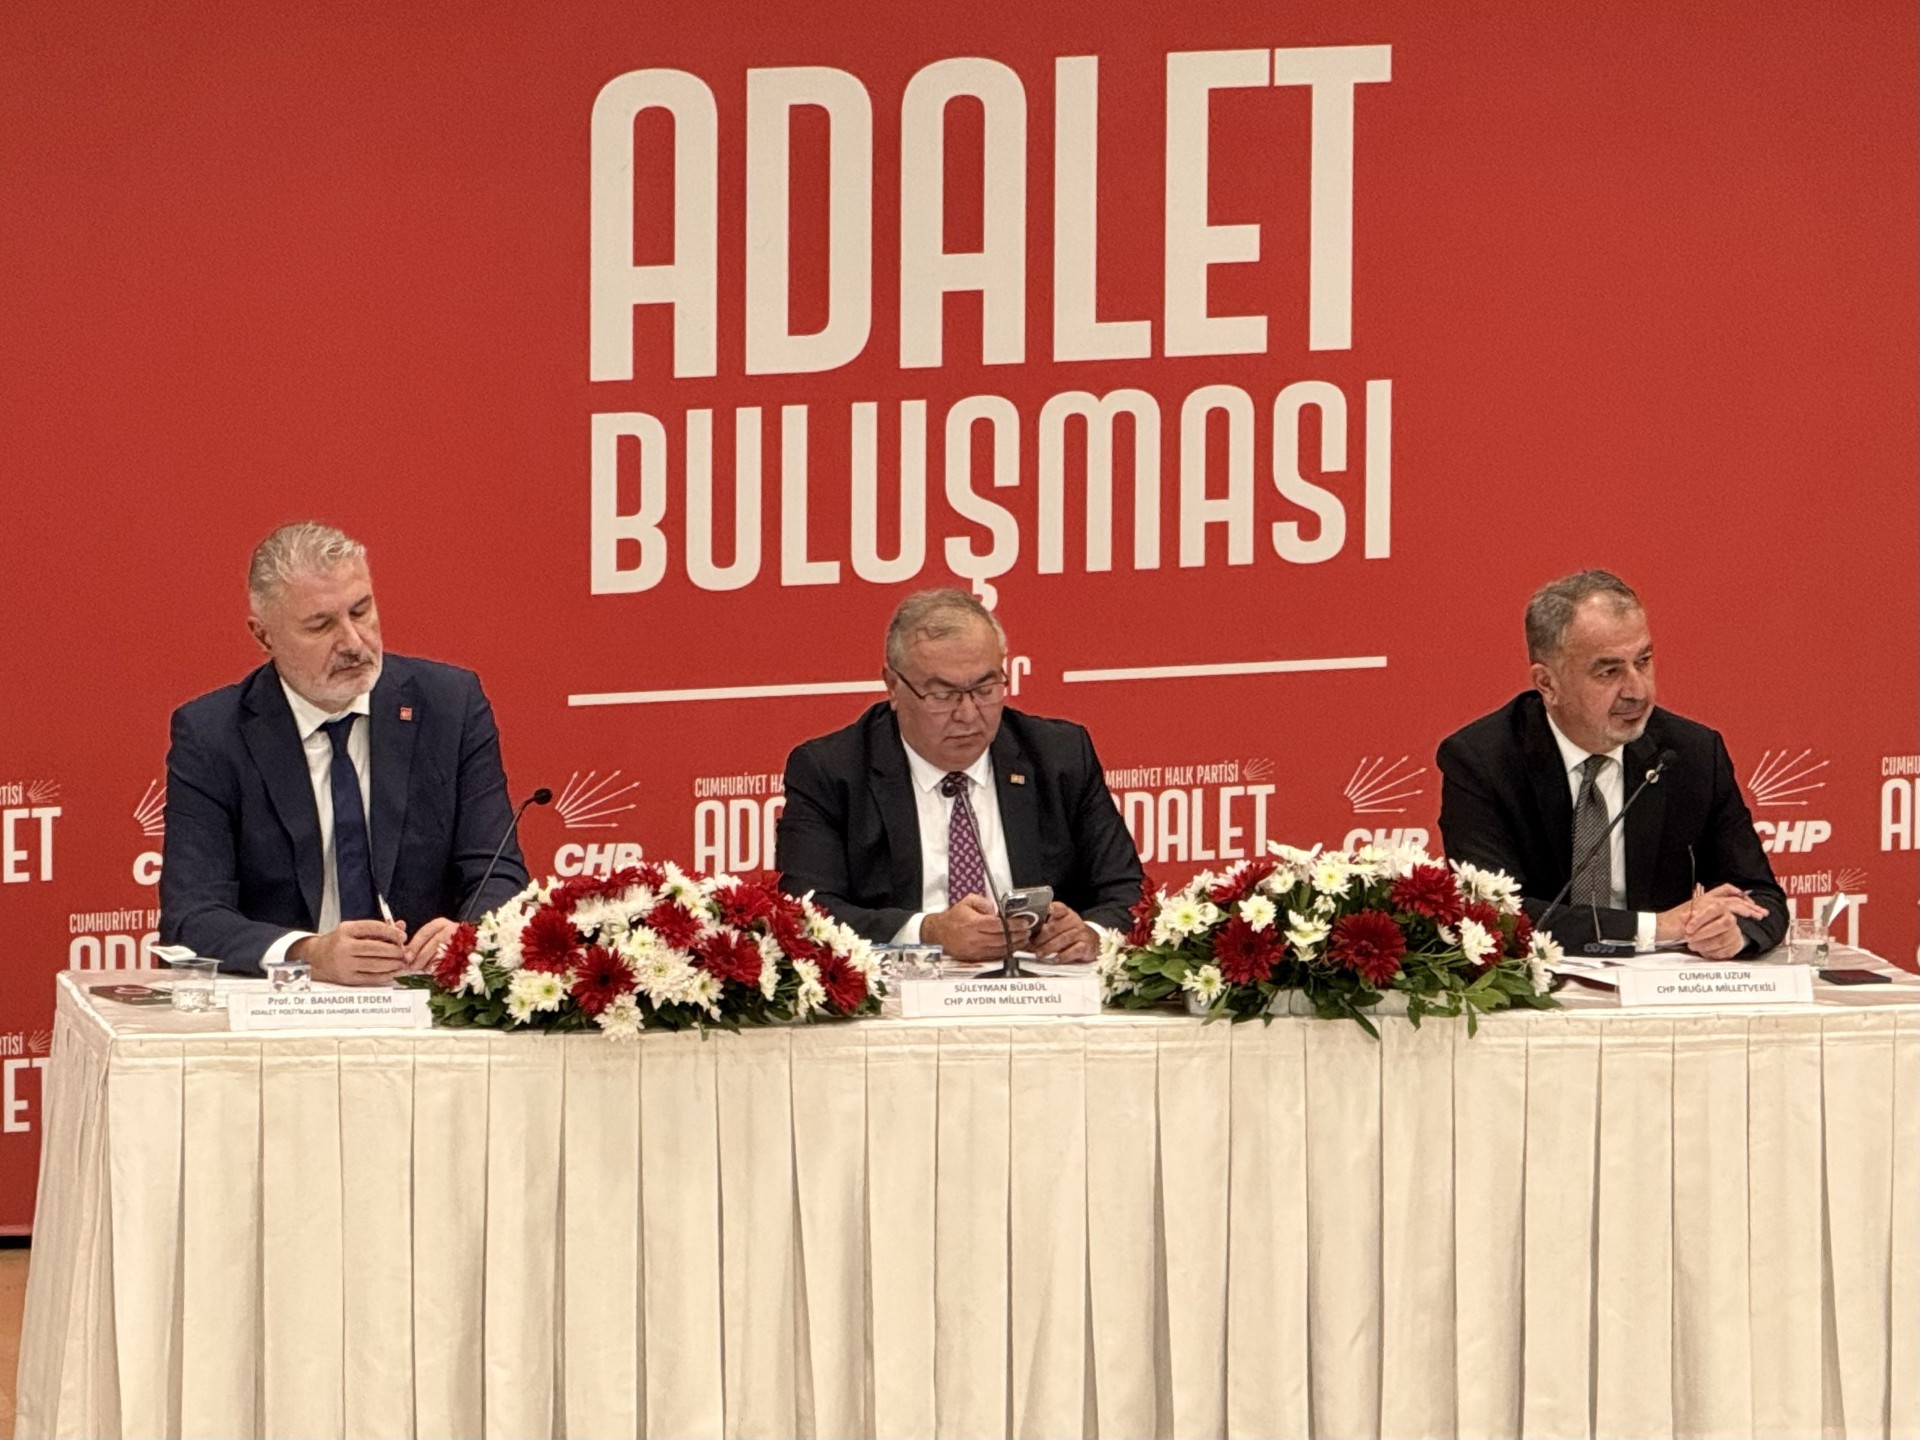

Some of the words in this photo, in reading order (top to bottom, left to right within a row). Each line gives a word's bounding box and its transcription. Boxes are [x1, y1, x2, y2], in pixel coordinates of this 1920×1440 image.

[590, 45, 1392, 384] ADALET
[590, 379, 1392, 611] BULUŞMASI
[695, 771, 768, 799] CUMHURİYET
[1105, 764, 1163, 789] MHURİYET
[1165, 766, 1194, 786] HALK
[1196, 759, 1239, 785] PARTİSİ
[1112, 783, 1276, 864] DALET
[1754, 820, 1832, 854] CHP
[1790, 870, 1832, 894] PARTİSİ
[69, 907, 144, 934] CUMHURİYET
[954, 982, 1008, 993] SÜLEYMAN
[1009, 981, 1048, 992] BÜLBÜL
[1656, 985, 1675, 994] CHP
[1678, 983, 1713, 994] MUĞLA
[1715, 981, 1776, 992] MİLLETVEKİLİ
[1678, 971, 1722, 981] CUMHUR
[1724, 971, 1751, 980] UZUN
[311, 995, 354, 1005] BAHADIR
[357, 995, 392, 1004] ERDEM
[944, 996, 964, 1006] CHP
[966, 996, 996, 1006] AYDIN
[998, 994, 1062, 1005] MİLLETVEKİLİ
